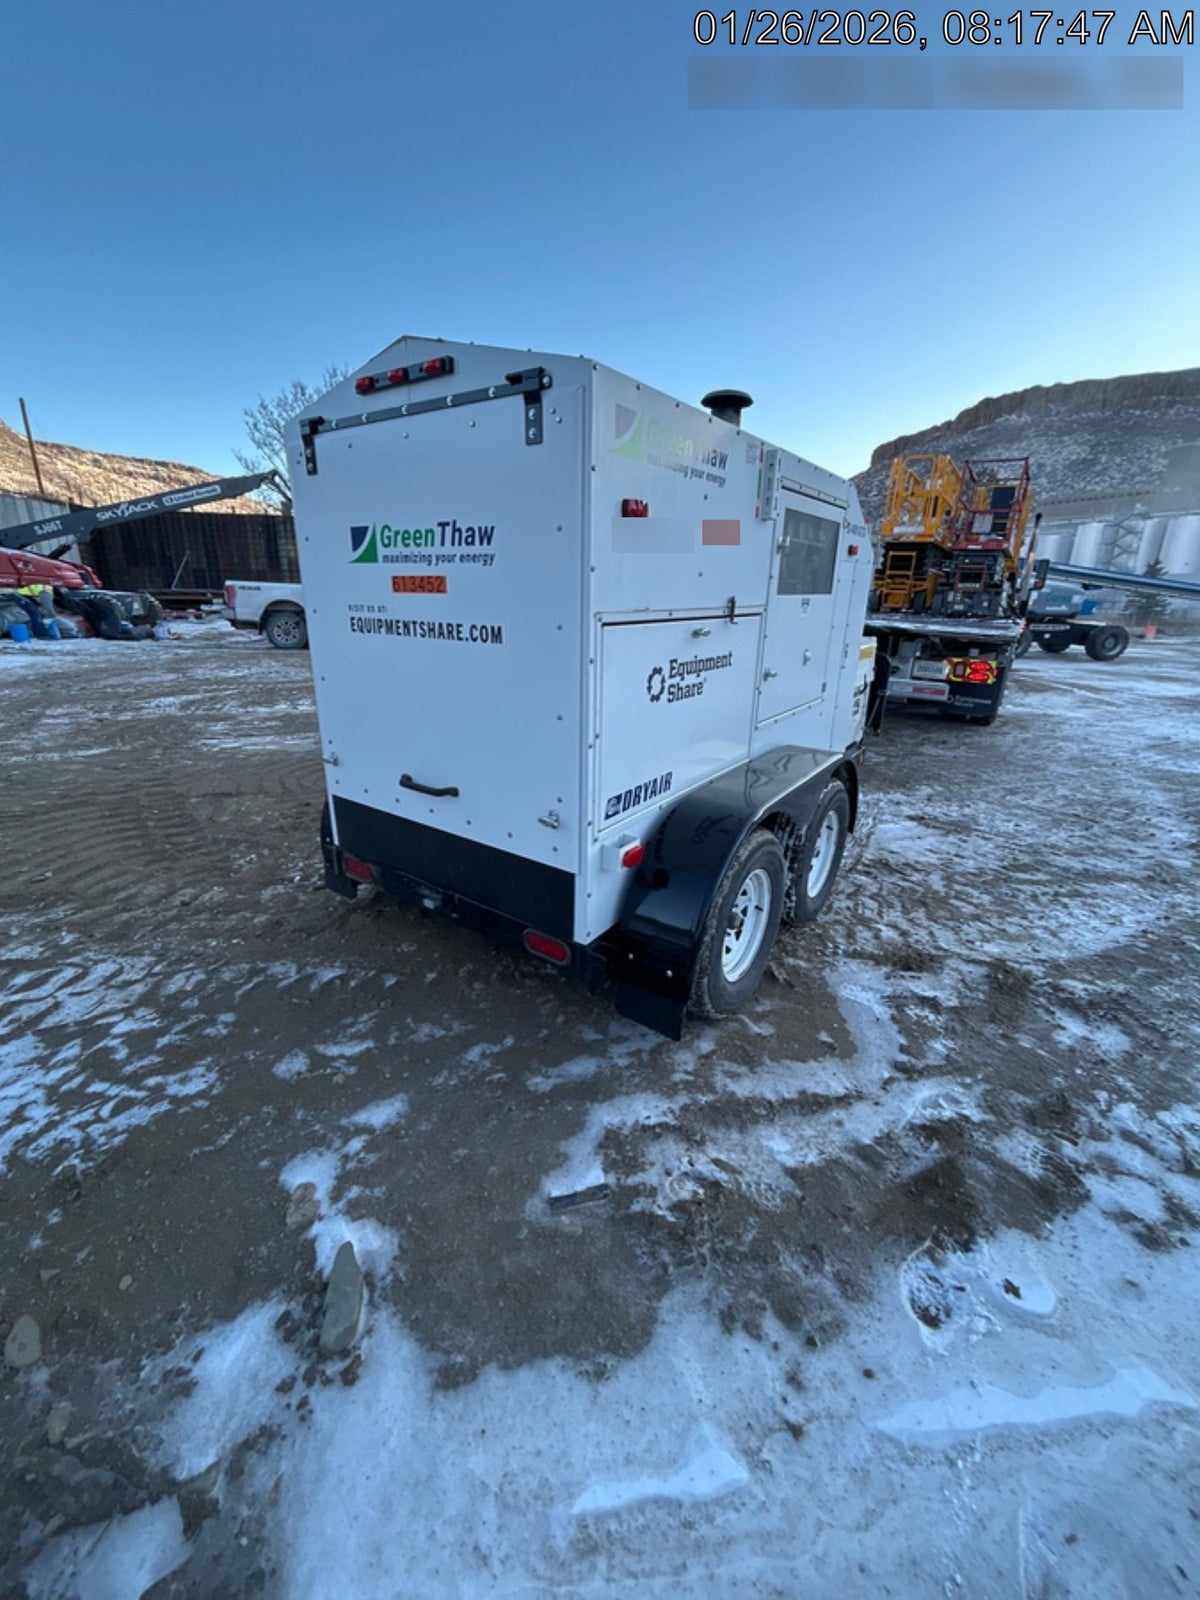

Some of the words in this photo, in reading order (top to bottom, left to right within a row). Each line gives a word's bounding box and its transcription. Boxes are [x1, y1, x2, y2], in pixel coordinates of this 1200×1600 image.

[647, 417, 729, 471] Geenhaw
[96, 501, 159, 522] SKYJACK
[382, 551, 432, 566] maximizing
[434, 553, 457, 567] your
[459, 552, 496, 567] energy
[350, 616, 503, 644] EQUIPMENTSHARE.COM
[668, 650, 733, 682] Equipment
[667, 680, 704, 703] Share
[622, 771, 673, 812] DRYAIR
